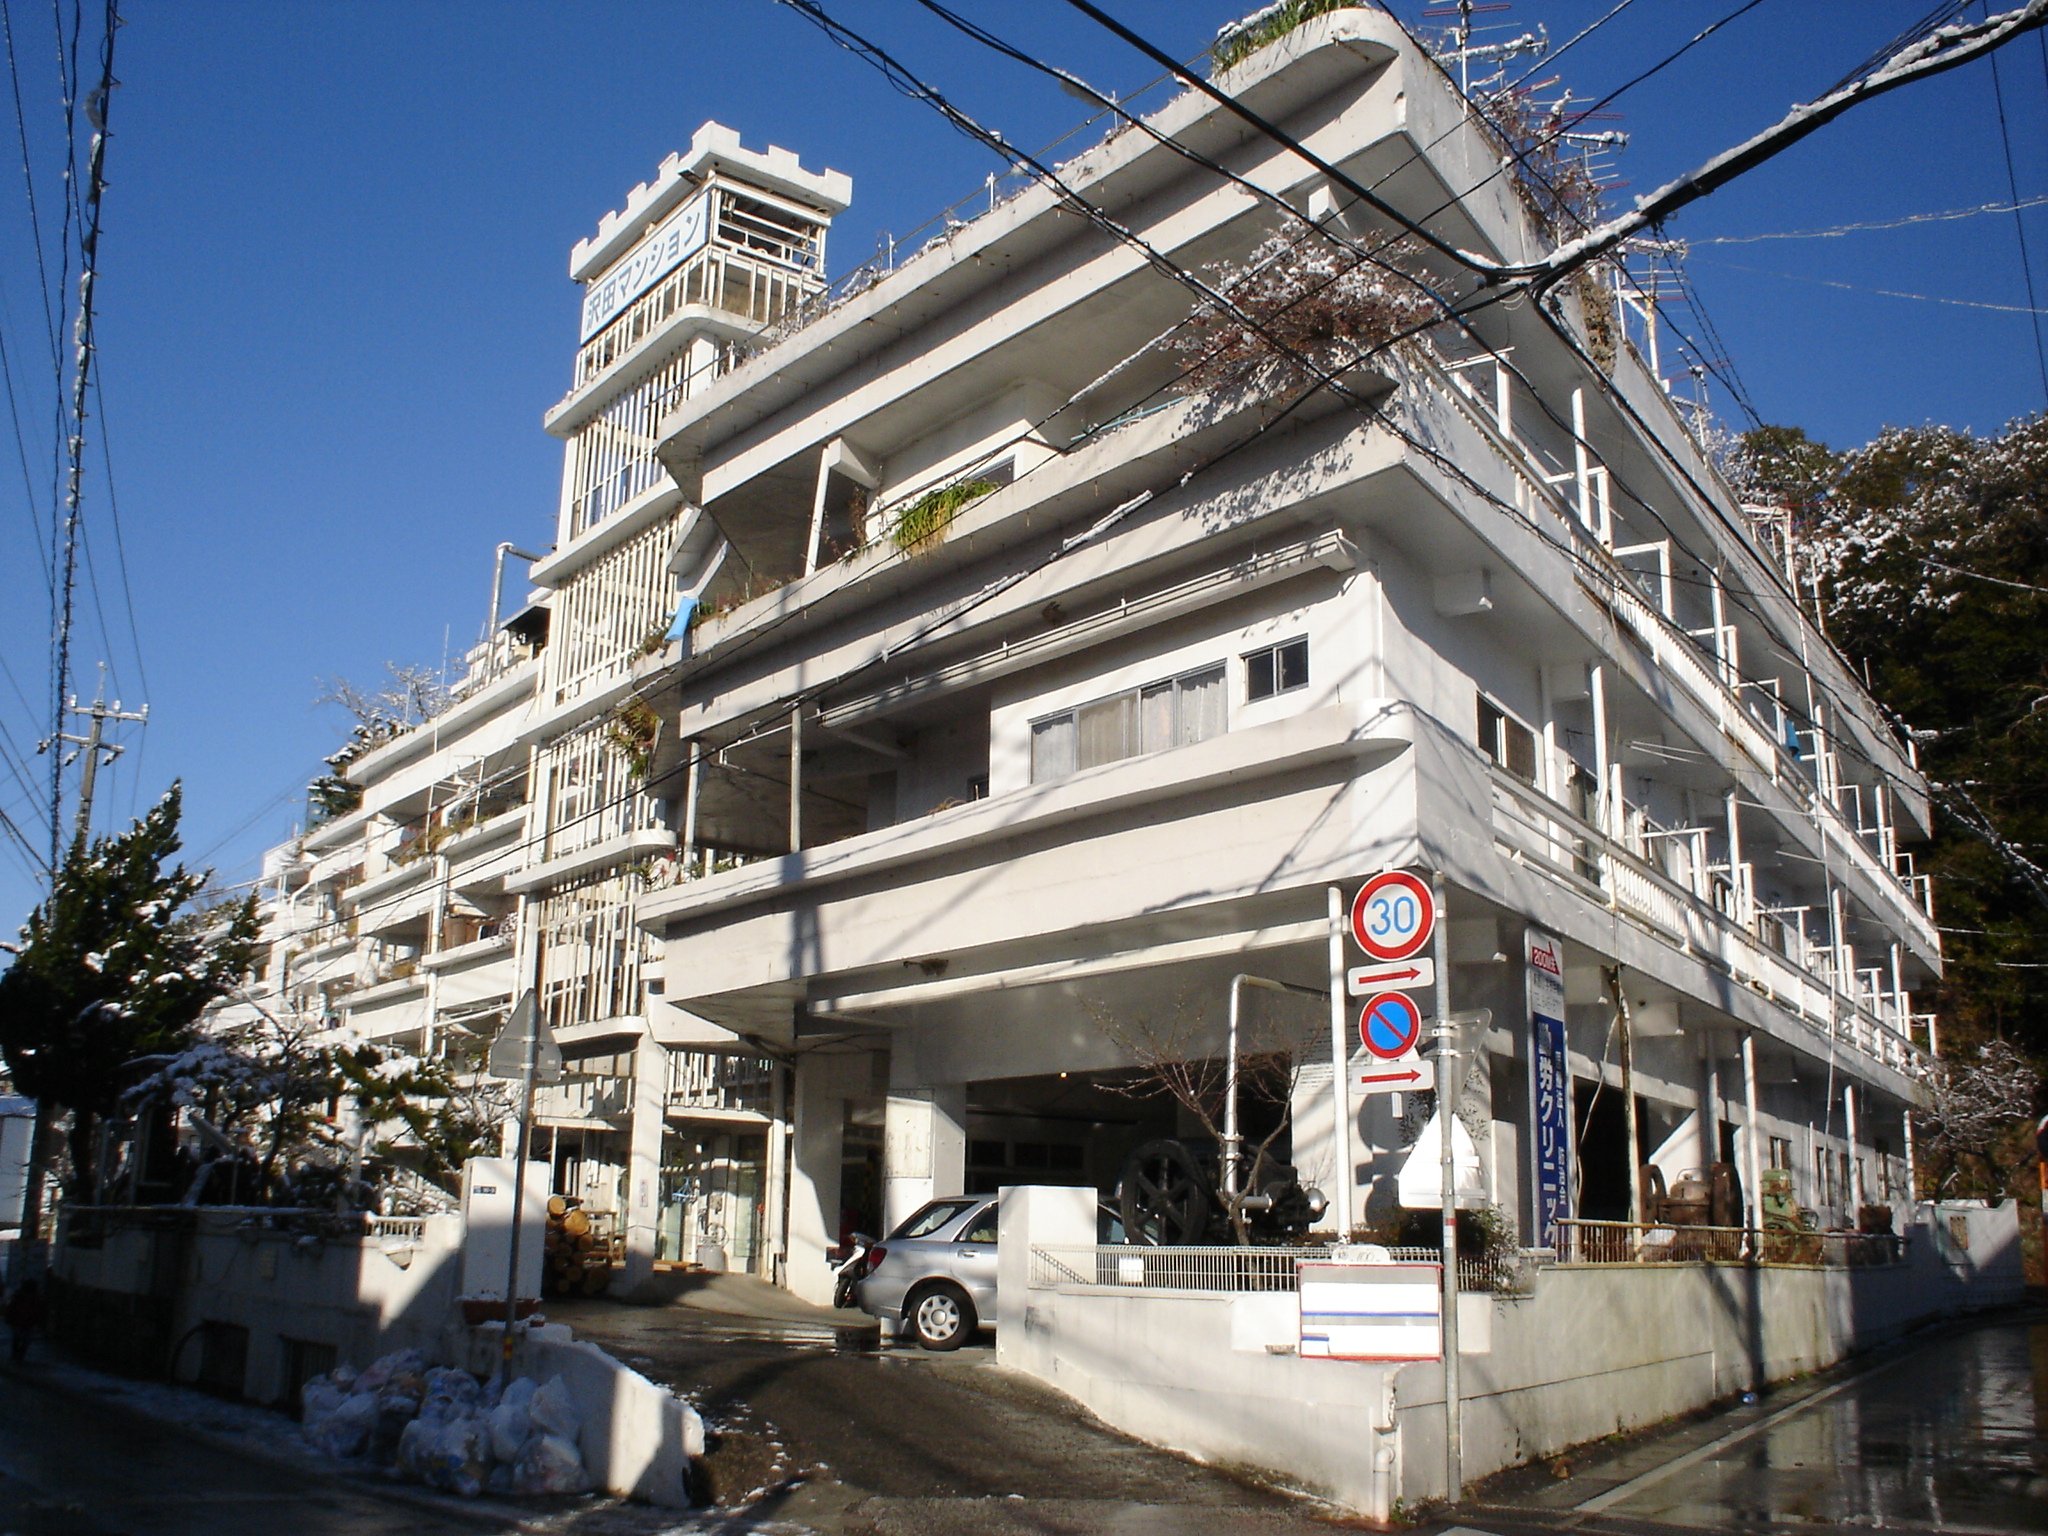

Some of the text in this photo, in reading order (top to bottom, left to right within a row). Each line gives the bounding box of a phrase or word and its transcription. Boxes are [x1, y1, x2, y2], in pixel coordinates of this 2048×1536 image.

[586, 212, 700, 331] 沢田マンション
[1370, 896, 1414, 936] 30
